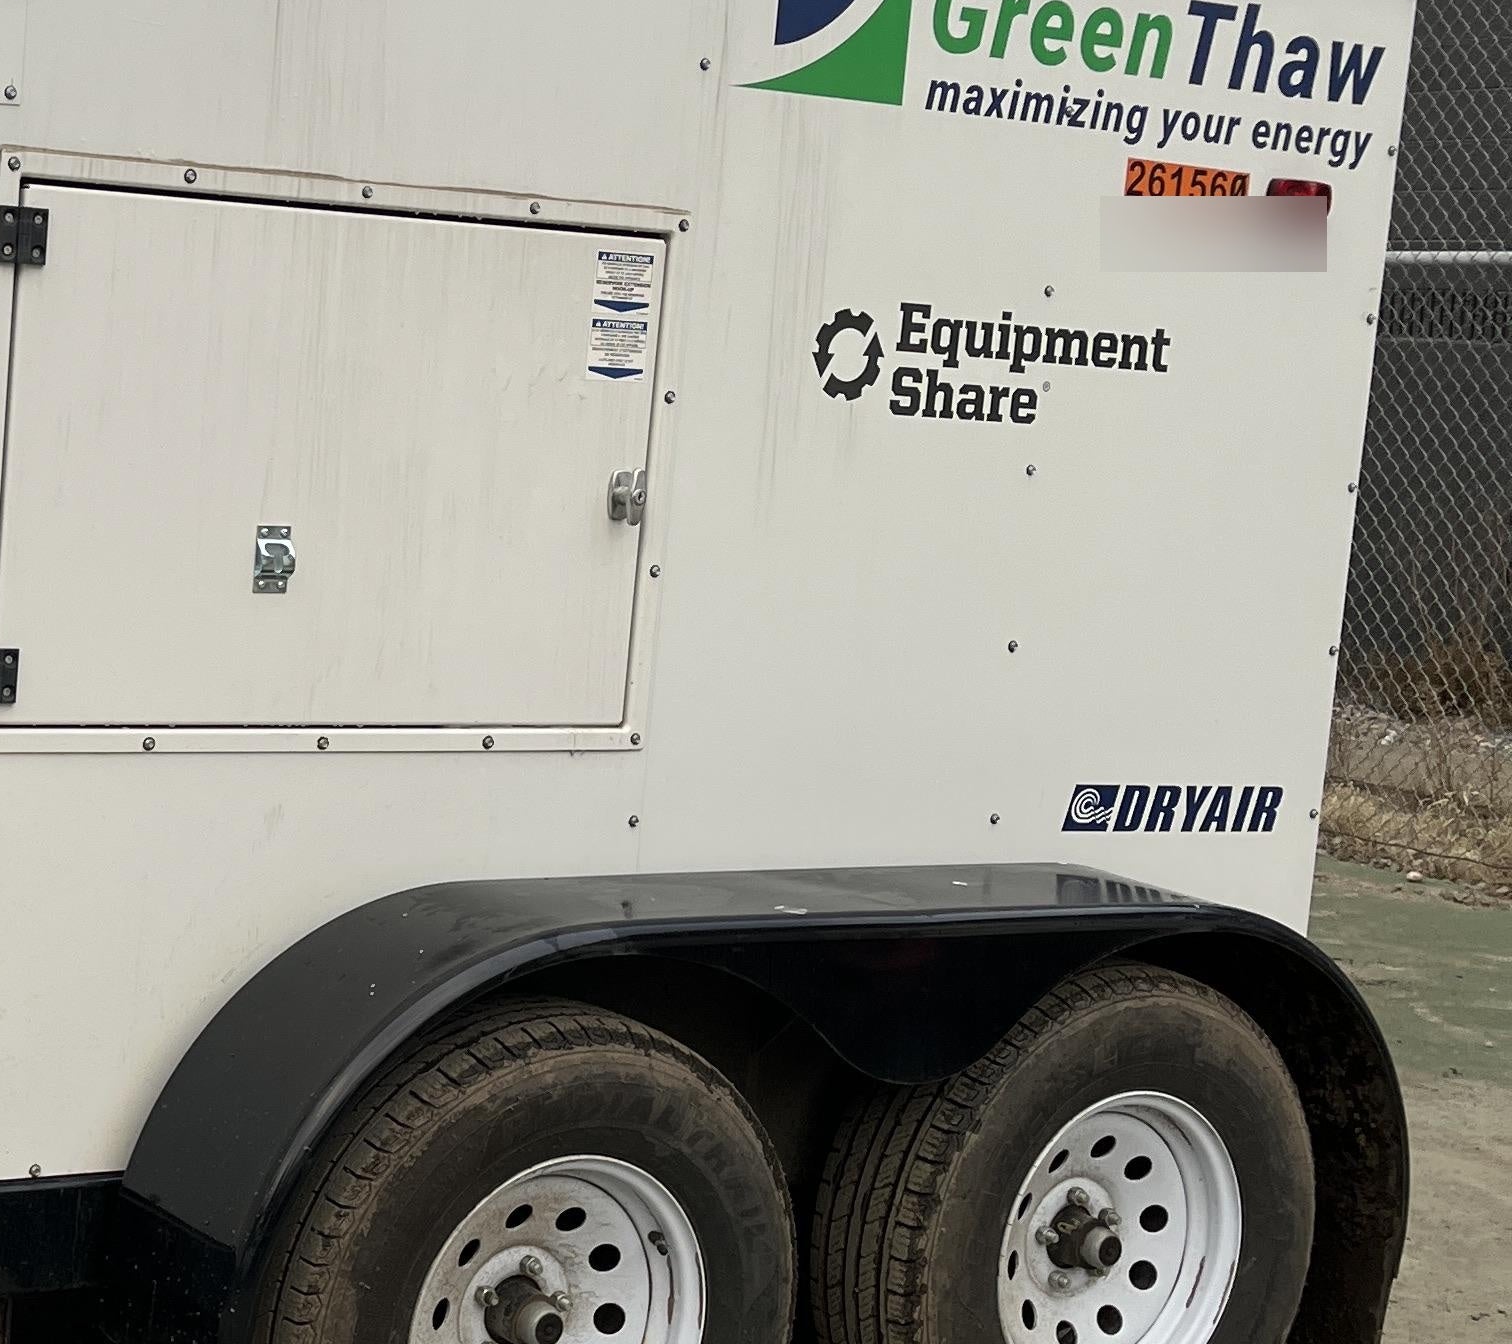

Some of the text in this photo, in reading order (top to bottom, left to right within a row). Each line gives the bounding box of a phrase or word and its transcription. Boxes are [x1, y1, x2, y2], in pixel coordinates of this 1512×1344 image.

[925, 78, 1374, 170] maximizing your energy
[896, 302, 1171, 374] Equipment
[1112, 785, 1284, 832] DRYAIR
